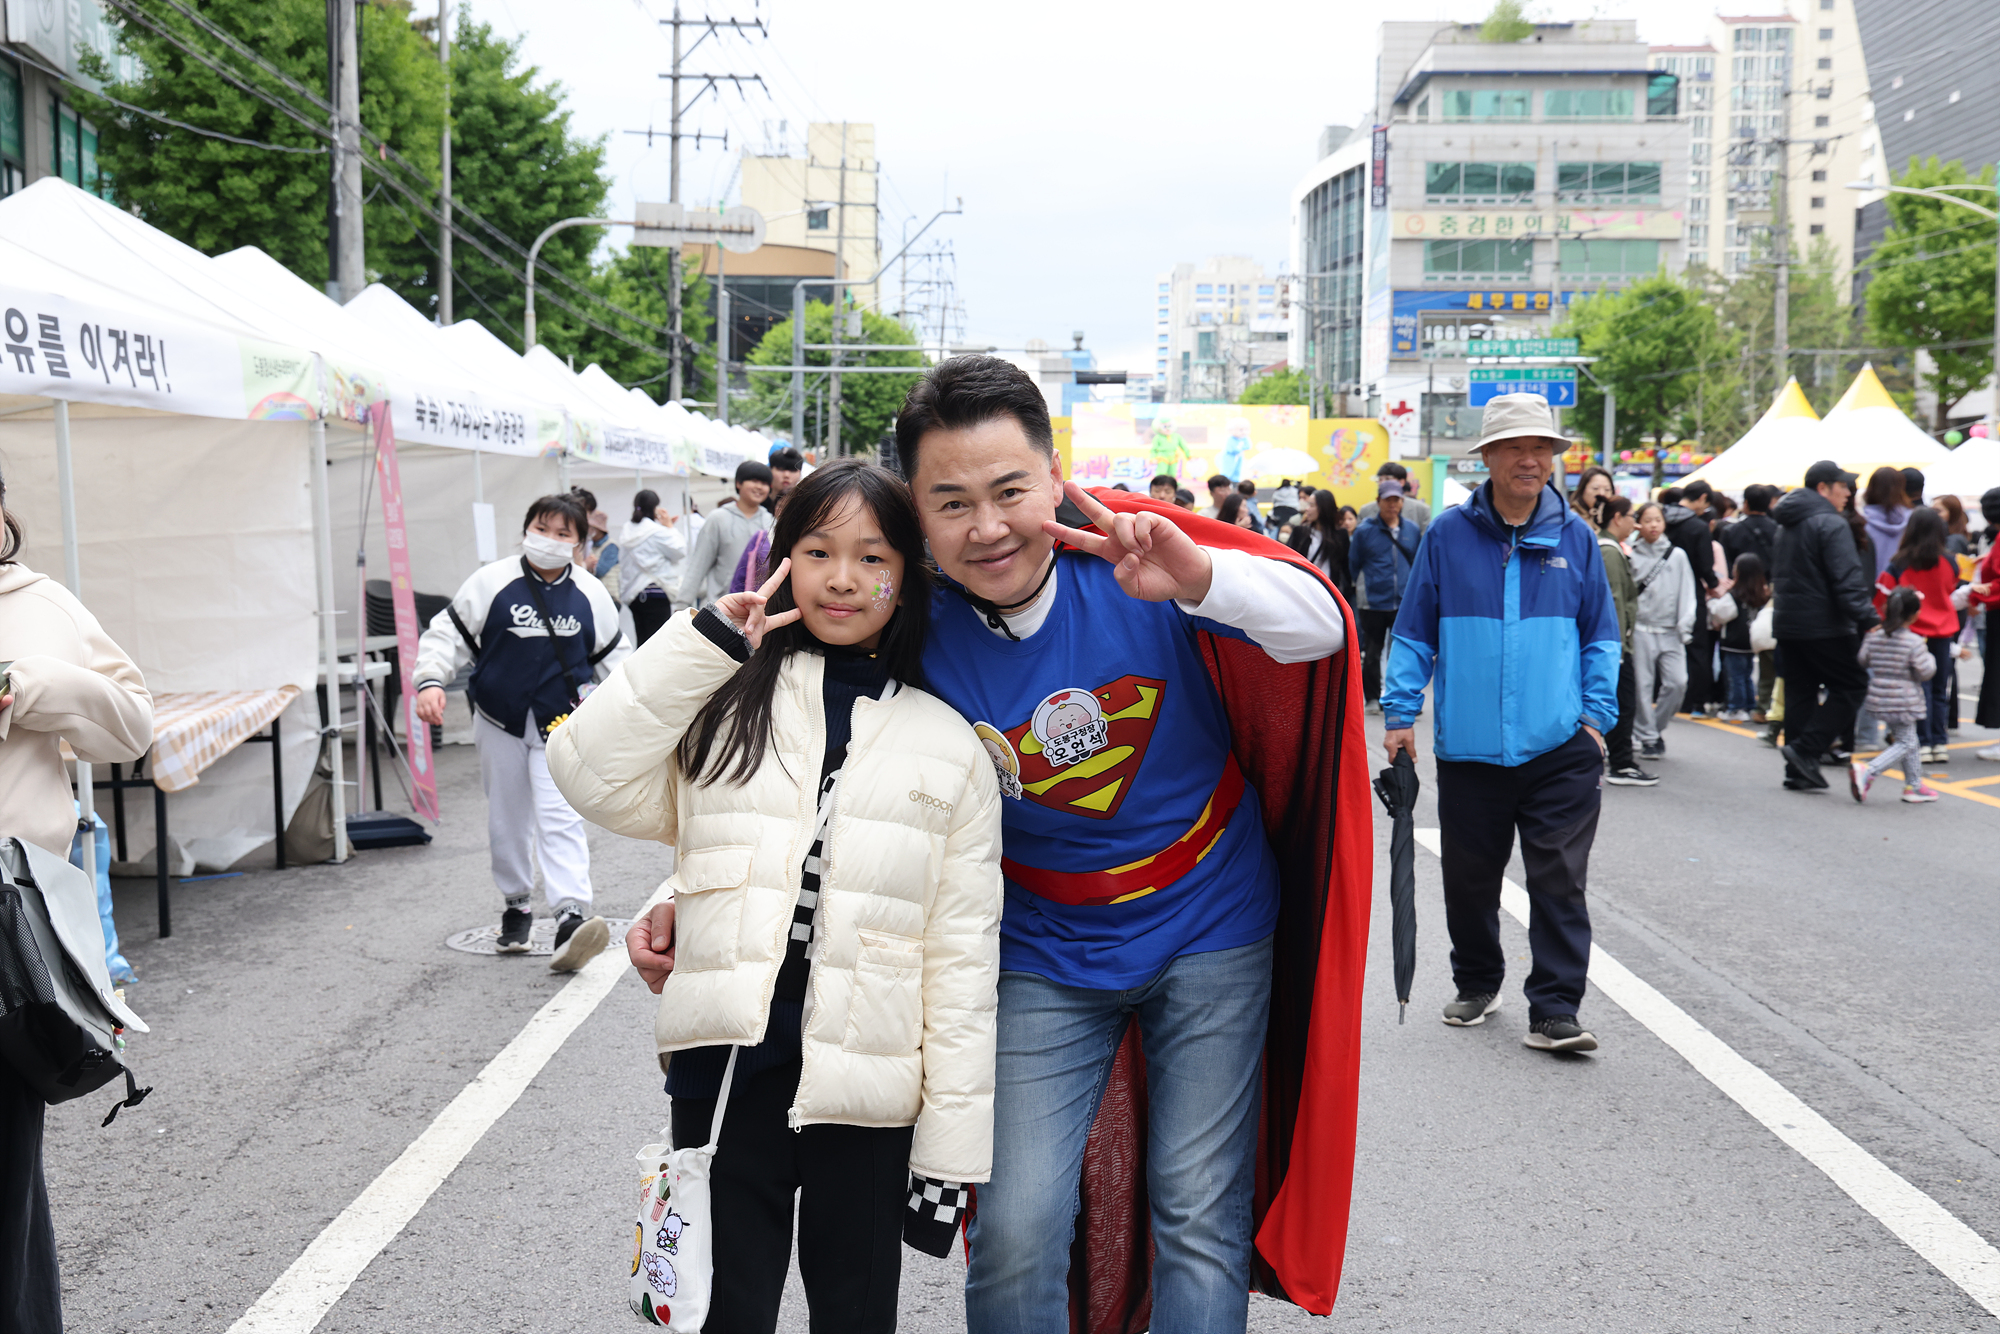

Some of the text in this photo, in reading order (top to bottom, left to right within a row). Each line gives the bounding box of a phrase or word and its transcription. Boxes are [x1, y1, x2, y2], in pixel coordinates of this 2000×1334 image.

[0, 307, 172, 394] 유를 이겨라!
[1457, 460, 1490, 472] GS2
[1053, 723, 1096, 748] 도봉구청장
